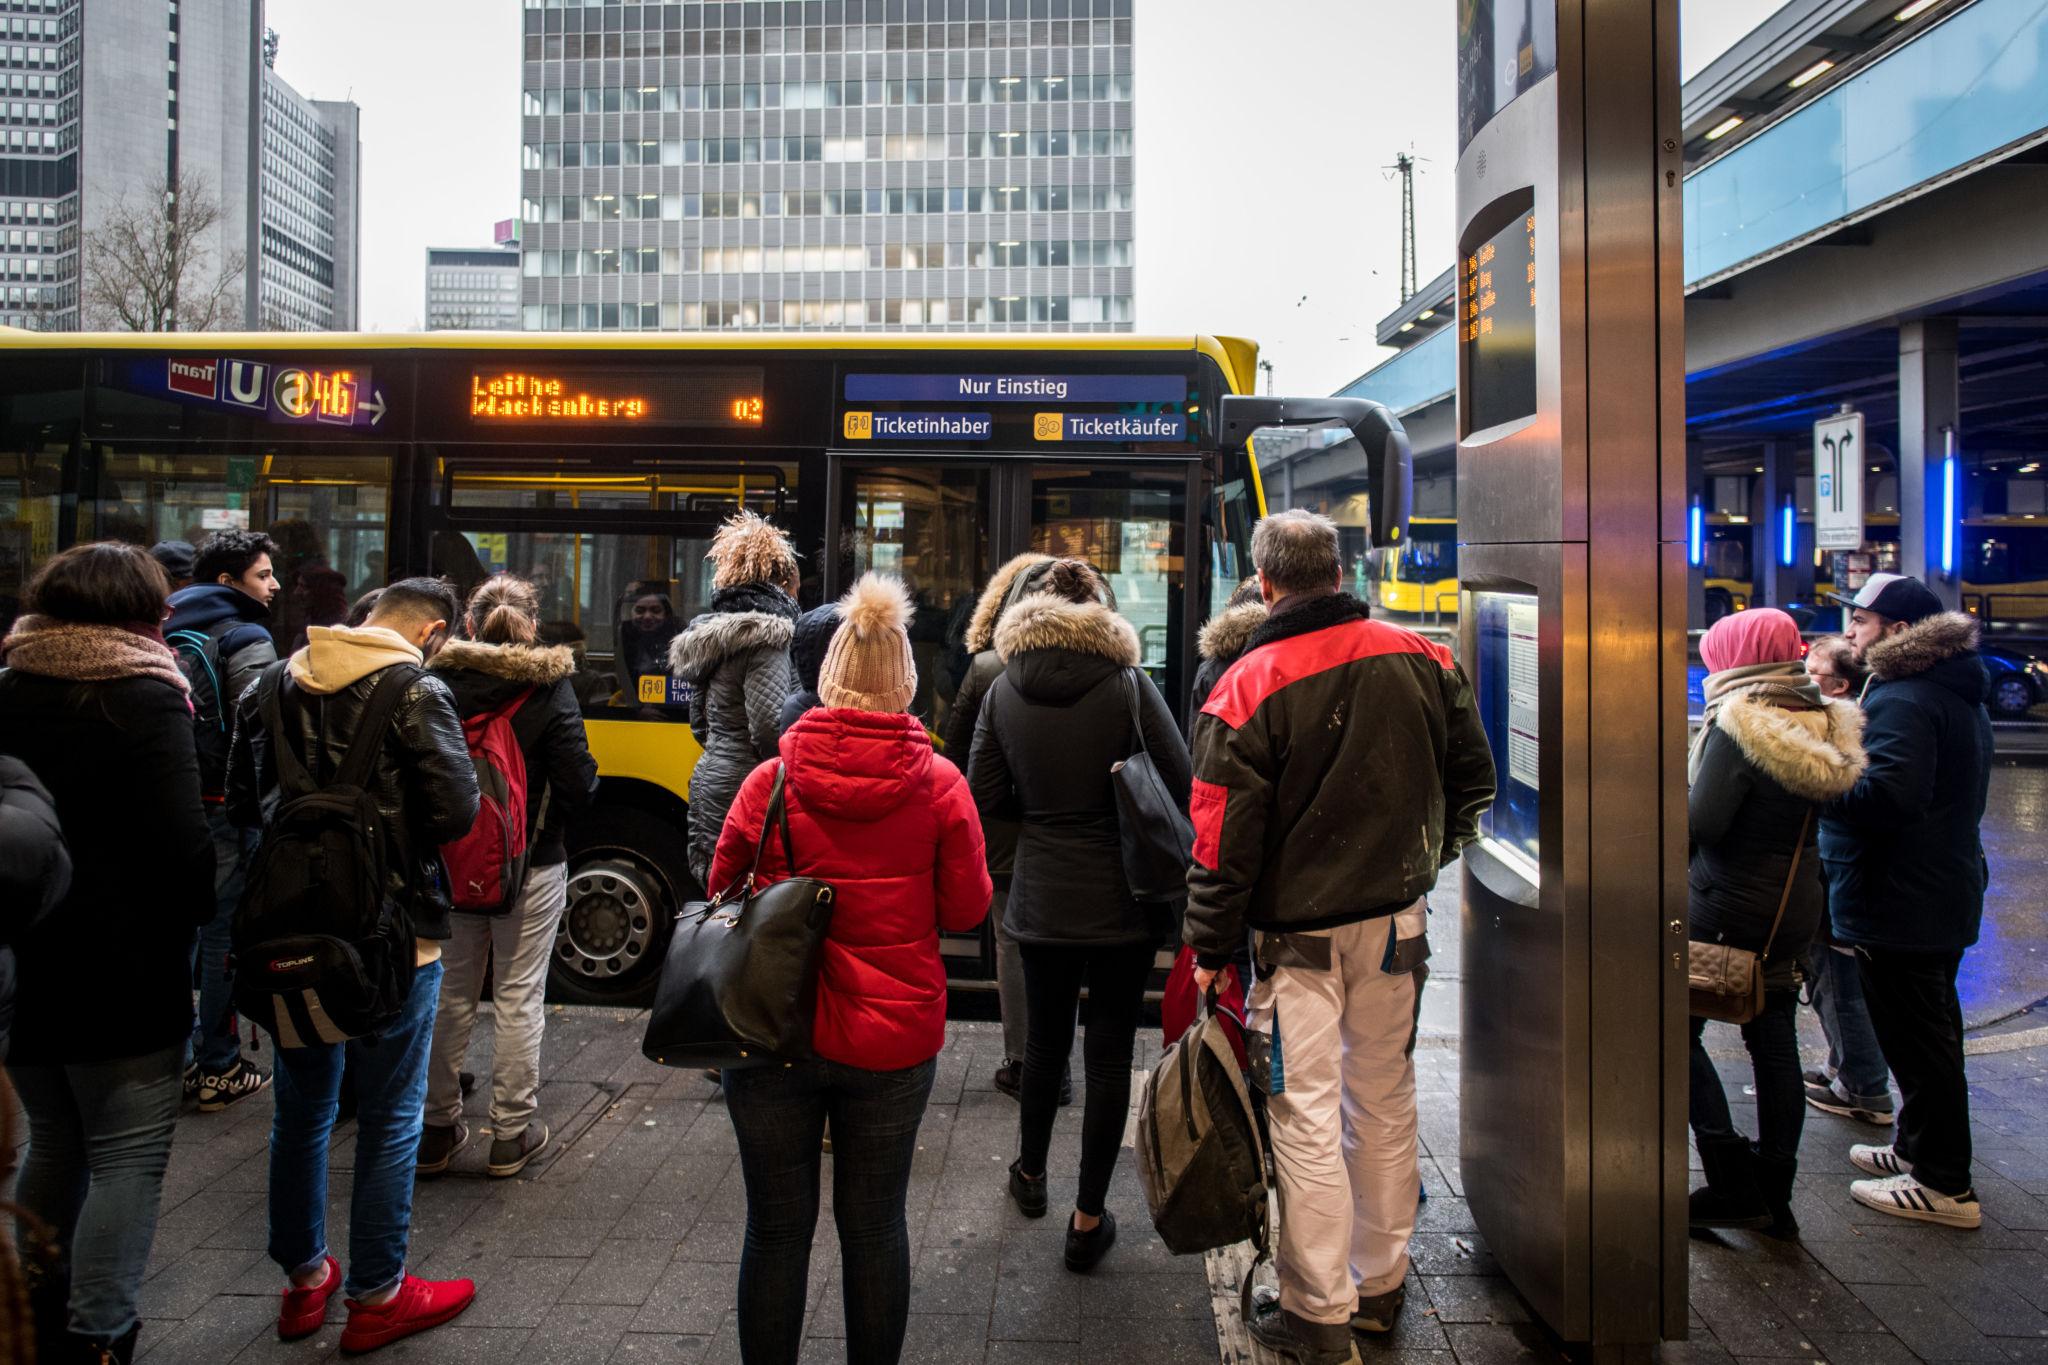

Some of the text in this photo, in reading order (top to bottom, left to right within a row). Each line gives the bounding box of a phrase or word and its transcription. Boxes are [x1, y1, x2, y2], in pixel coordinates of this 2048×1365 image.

[473, 375, 560, 395] Leithe
[959, 378, 1068, 398] Nur Einstieg
[875, 417, 989, 434] Ticketinhaber
[1070, 418, 1178, 436] Ticketkäufer
[672, 691, 692, 701] Tick
[276, 955, 315, 969] TOPLINE
